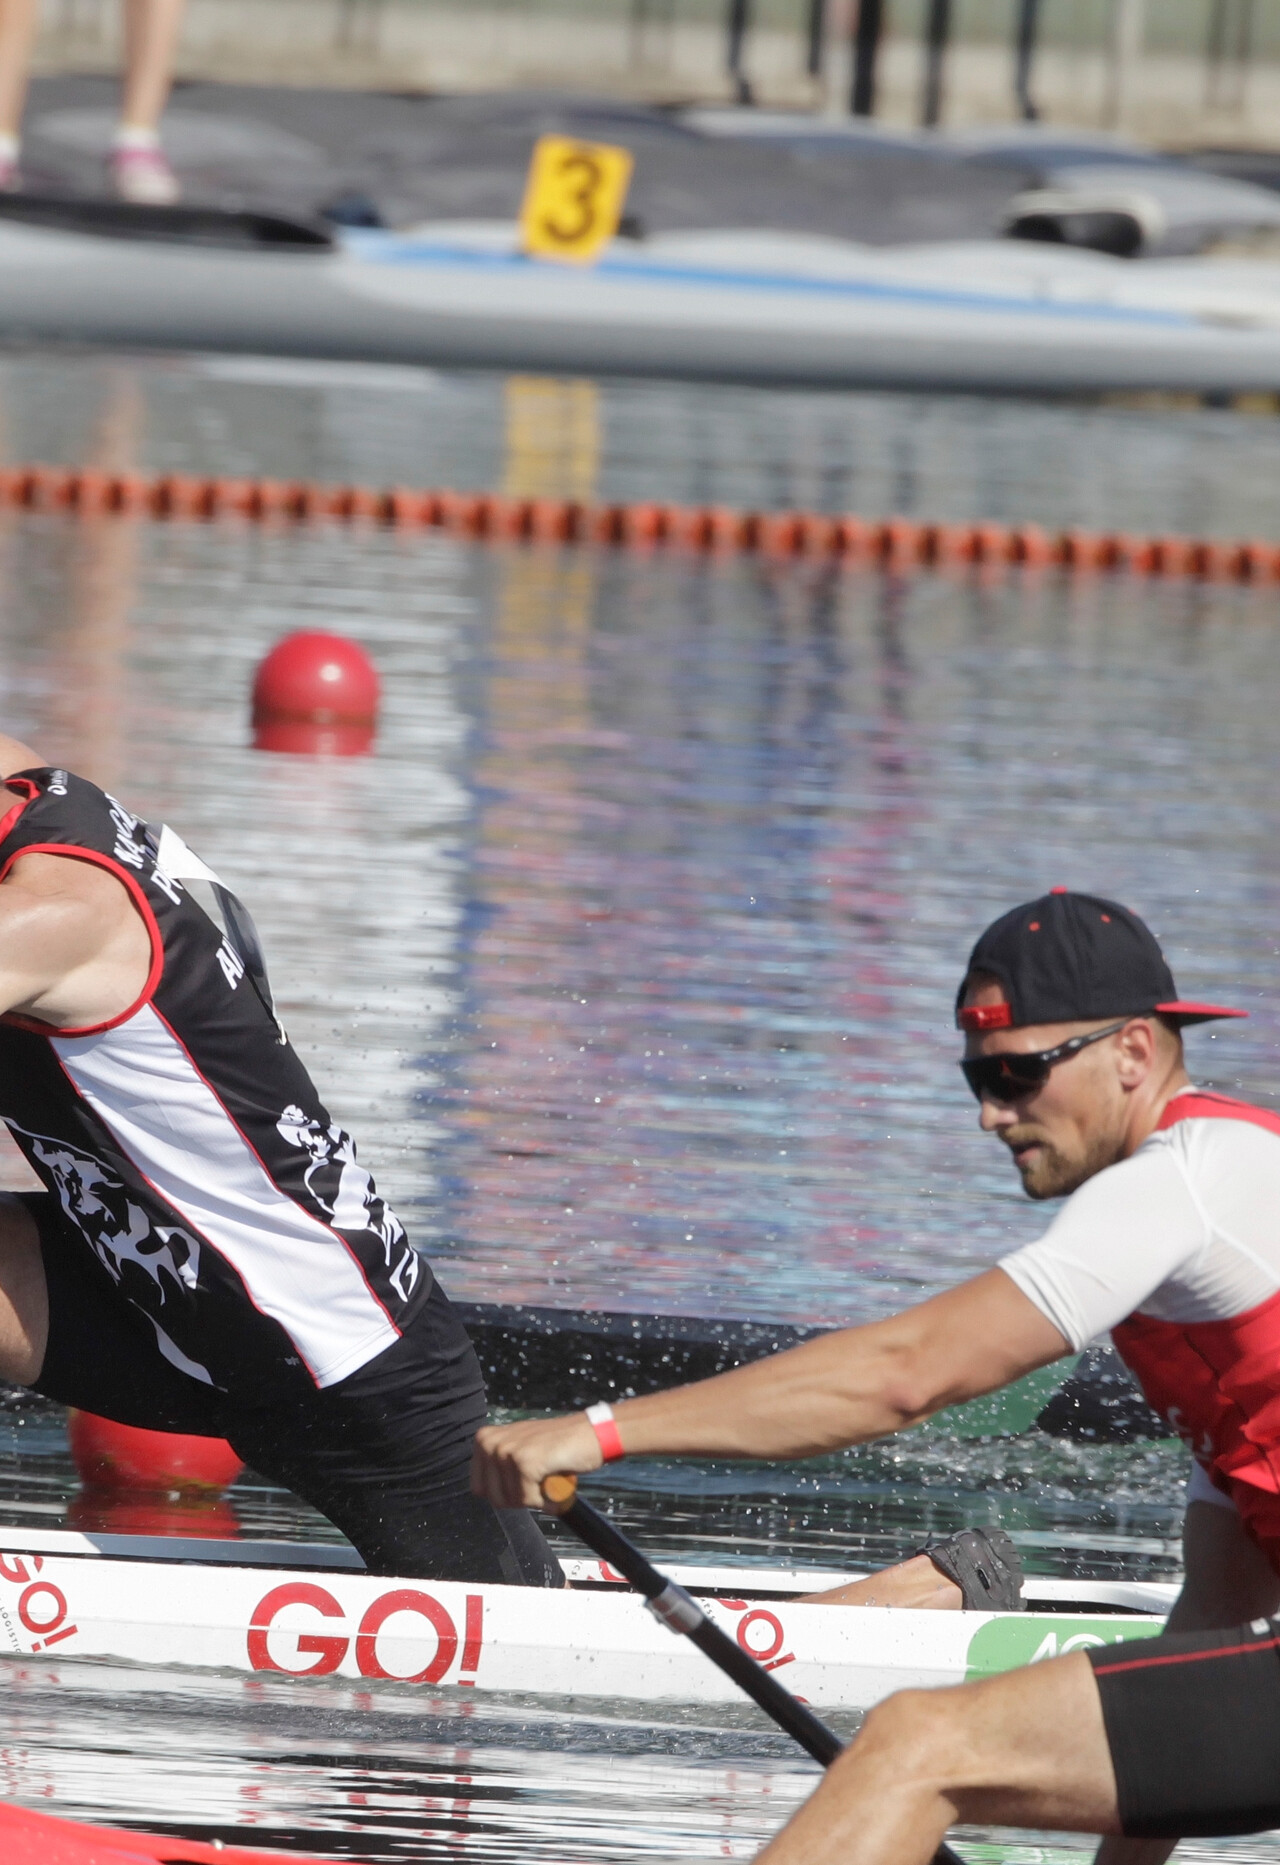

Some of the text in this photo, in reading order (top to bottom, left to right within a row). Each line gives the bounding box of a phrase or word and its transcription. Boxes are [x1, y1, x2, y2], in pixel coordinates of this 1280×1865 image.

[542, 155, 605, 246] 3
[0, 1606, 22, 1653] LOGISTIC
[247, 1581, 483, 1686] GO!
